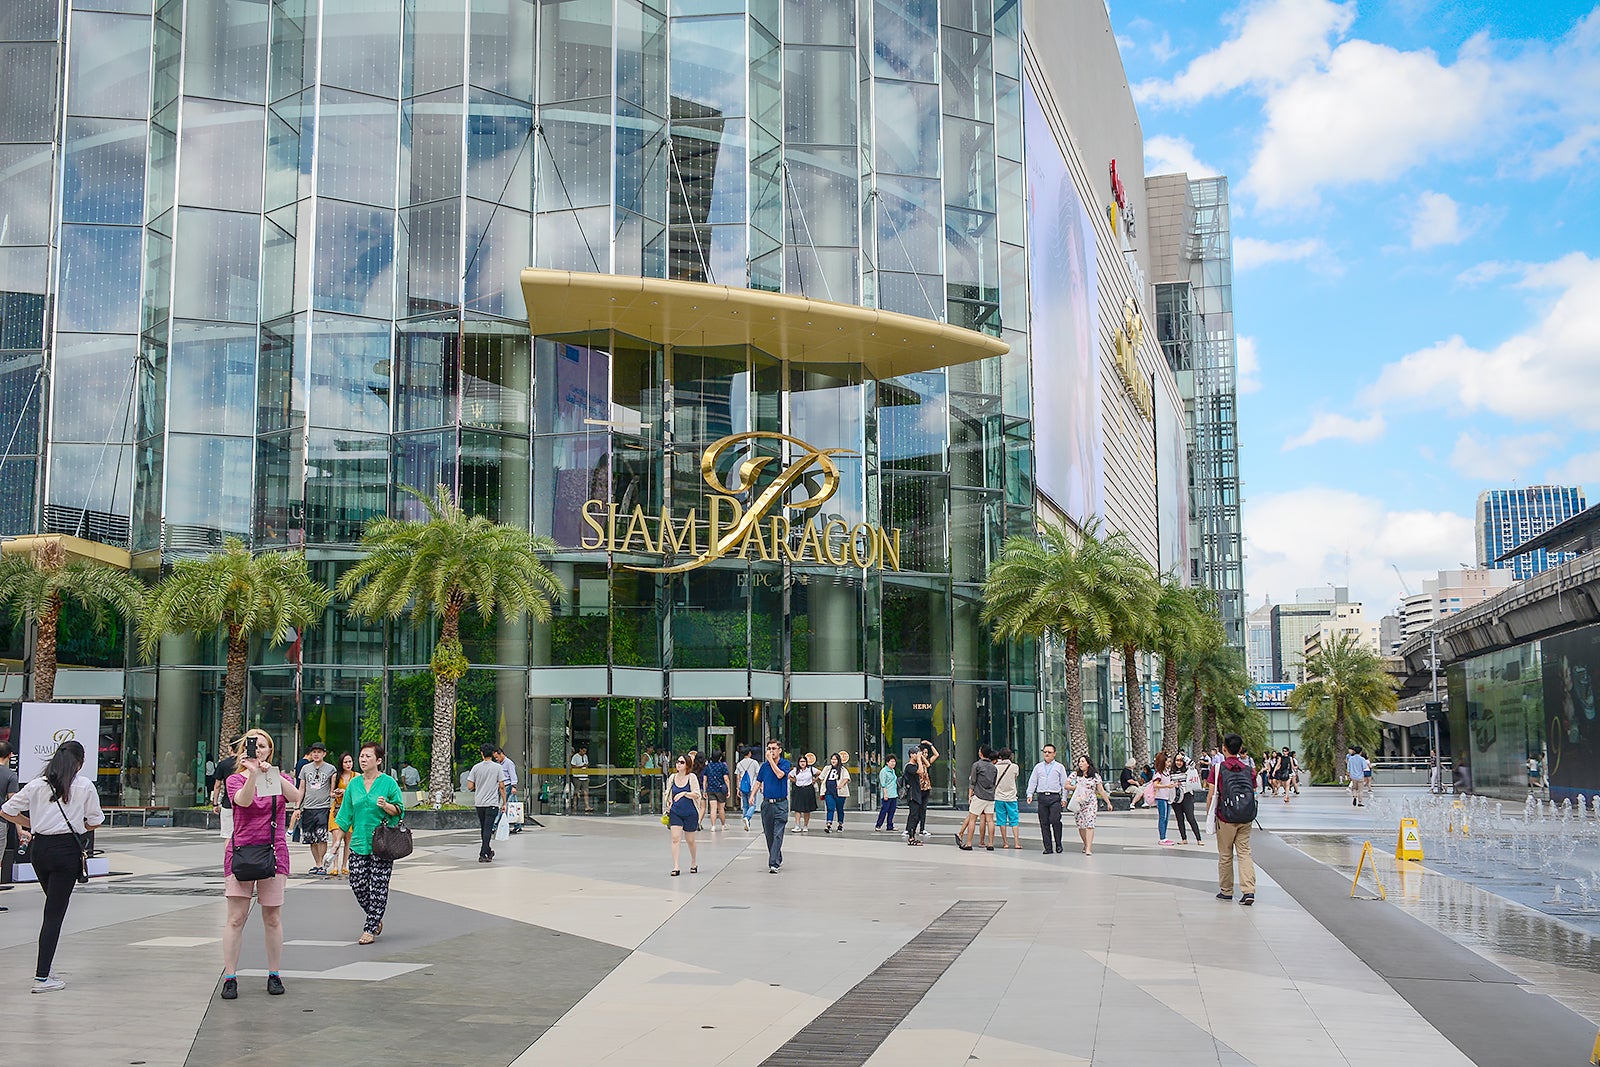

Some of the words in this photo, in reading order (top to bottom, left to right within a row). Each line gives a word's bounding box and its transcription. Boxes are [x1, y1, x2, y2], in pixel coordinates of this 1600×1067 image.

[581, 499, 701, 556] SIAM
[703, 493, 902, 572] PARAGON
[34, 744, 52, 755] SIAM
